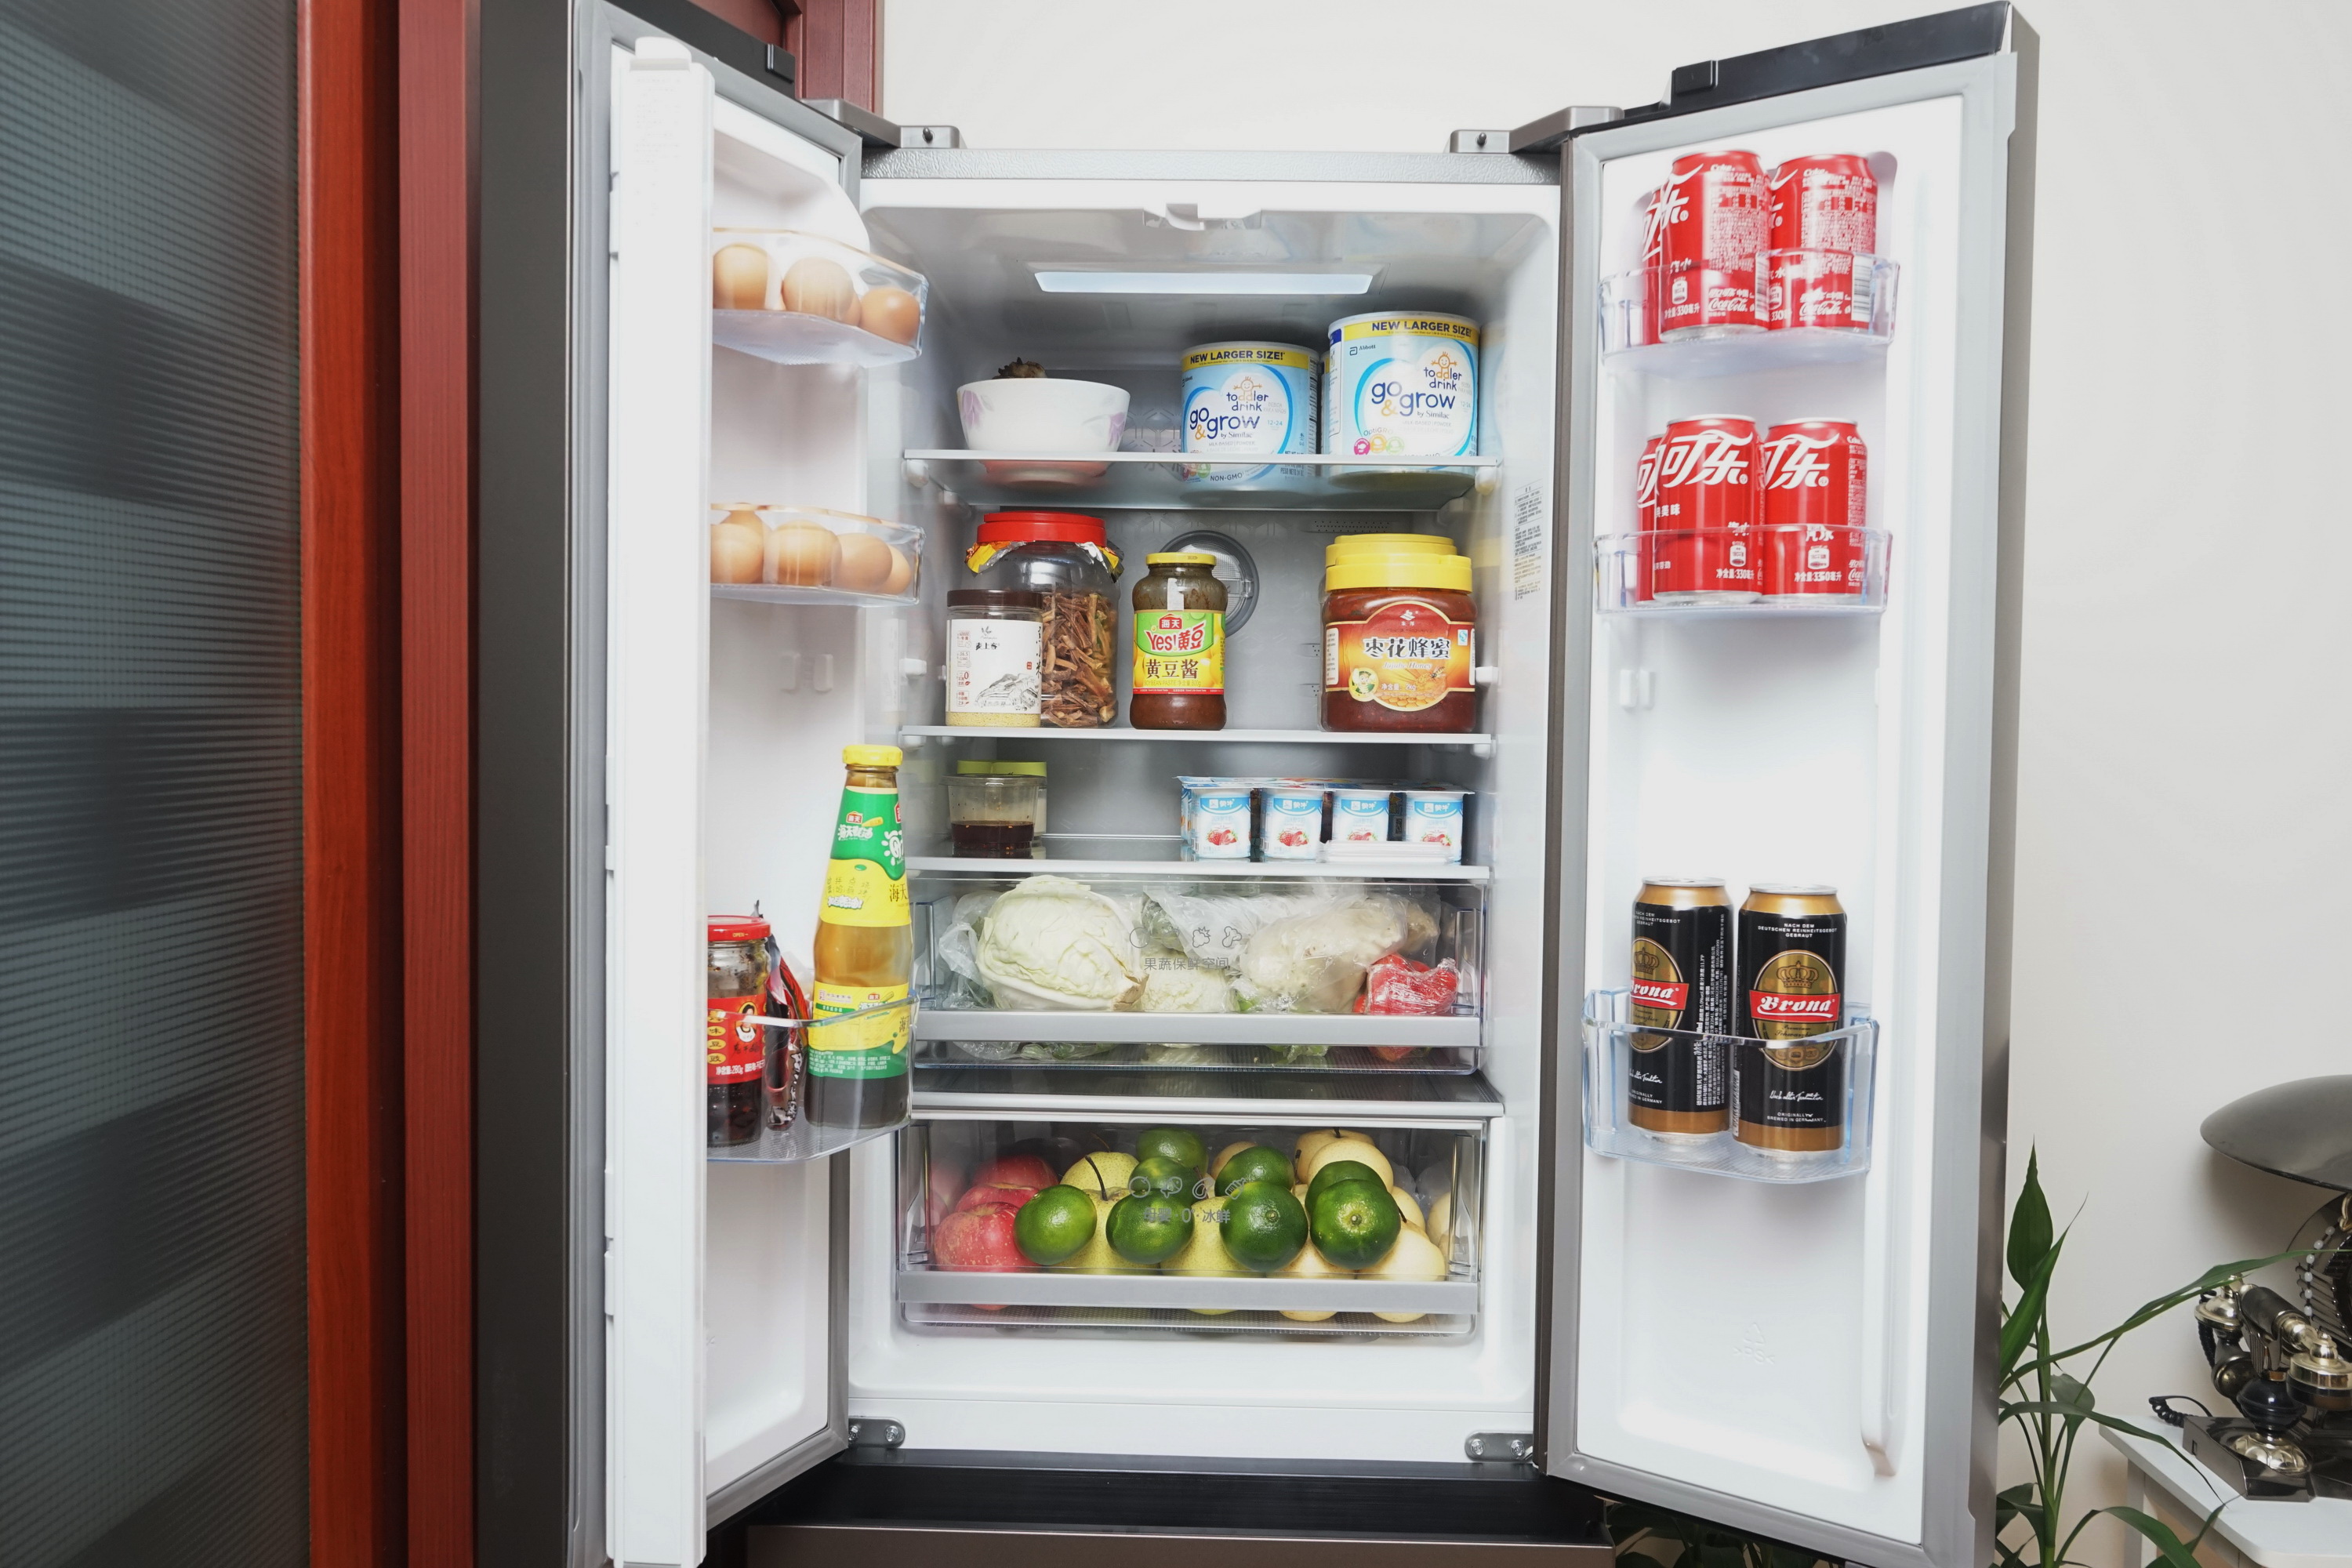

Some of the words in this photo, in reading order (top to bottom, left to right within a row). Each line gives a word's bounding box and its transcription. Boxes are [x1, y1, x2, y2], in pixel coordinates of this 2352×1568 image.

[1372, 321, 1399, 331] NEW
[1404, 321, 1450, 332] LARGER
[1190, 353, 1208, 364] NEW
[1210, 350, 1253, 361] LARGER
[1424, 366, 1462, 380] toddler
[1429, 378, 1457, 391] drink
[1226, 392, 1269, 402] toddler
[1371, 381, 1403, 405] go
[1232, 401, 1262, 412] drink
[1381, 400, 1397, 416] &
[1399, 392, 1456, 416] grow
[1189, 407, 1210, 430] go
[1195, 425, 1207, 441] &
[1207, 416, 1260, 439] grow
[1161, 619, 1181, 629] 海天
[1363, 638, 1450, 659] 枣花蜂蜜
[1145, 659, 1198, 679] 黄豆酱
[1144, 957, 1229, 971] 果蔬保鲜空间
[1758, 996, 1831, 1013] Brona
